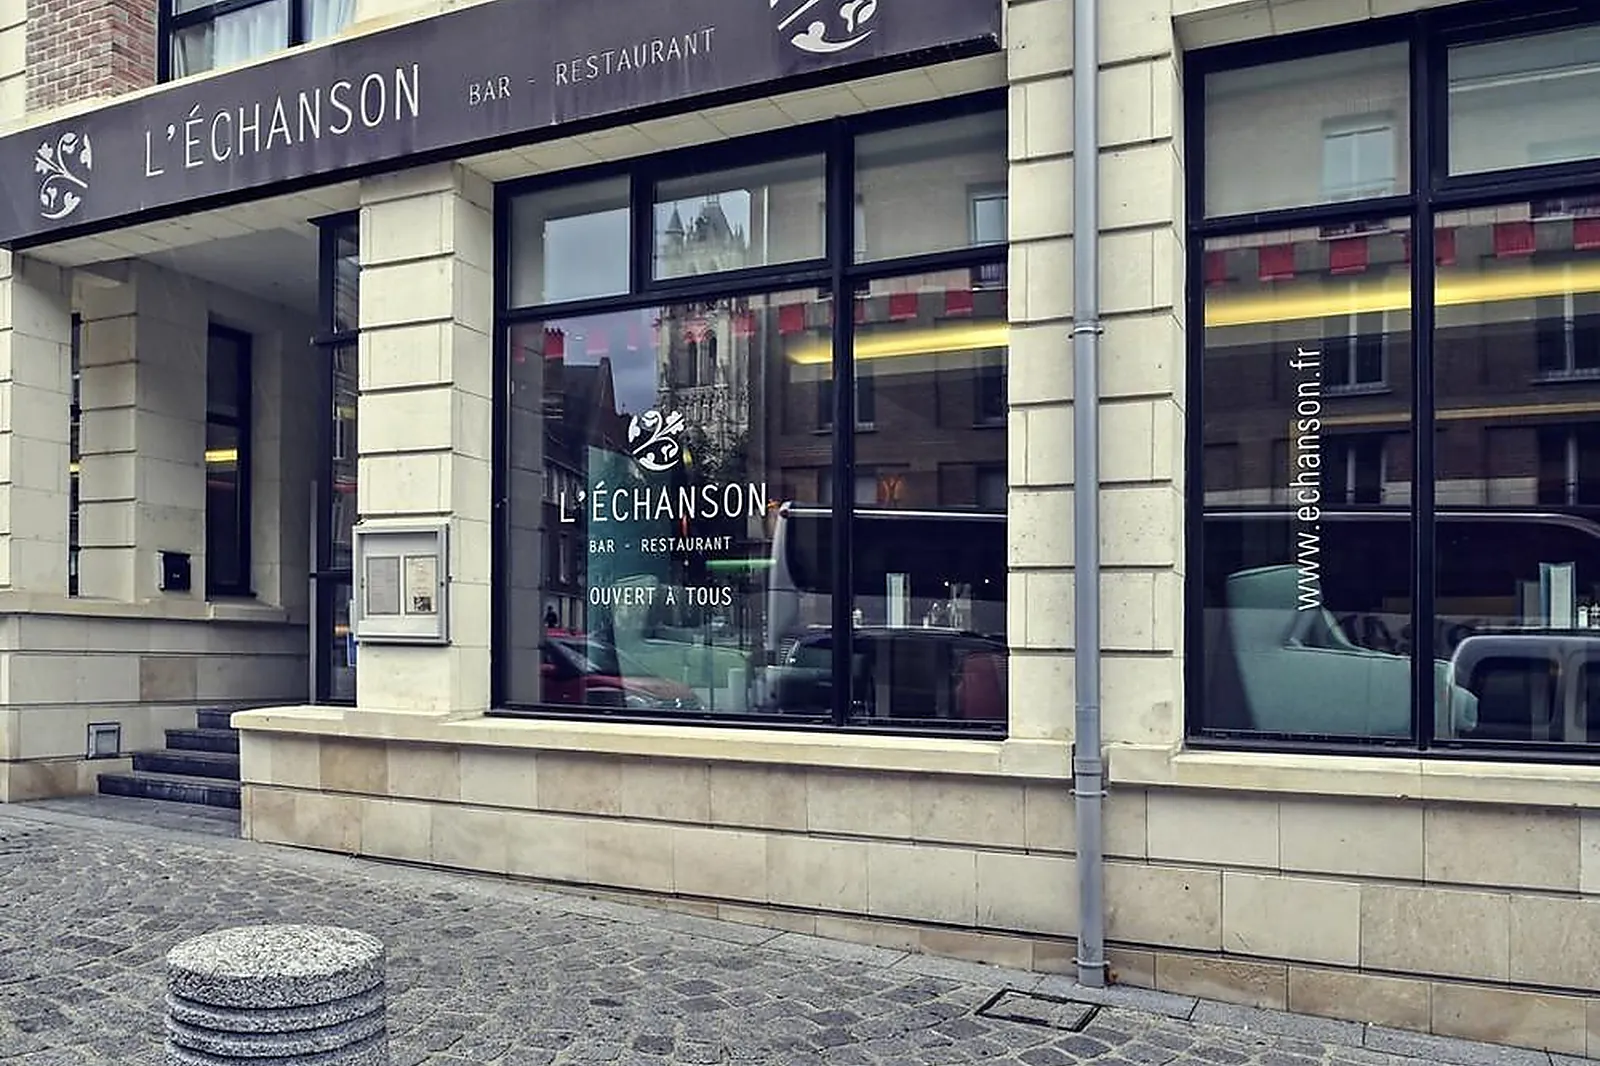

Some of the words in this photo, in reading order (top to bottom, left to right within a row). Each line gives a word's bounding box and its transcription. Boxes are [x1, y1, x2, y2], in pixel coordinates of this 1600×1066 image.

[145, 63, 419, 177] L'ÉCHANSON
[469, 76, 511, 106] BAR
[555, 27, 716, 86] RESTAURANT
[1290, 347, 1321, 611] www.echanson.fr
[559, 480, 767, 523] L'ÉCHANSON
[589, 539, 615, 553] BAR
[641, 535, 732, 552] RESTAURANT
[589, 587, 656, 606] OUVERT
[685, 586, 733, 606] TOUS
